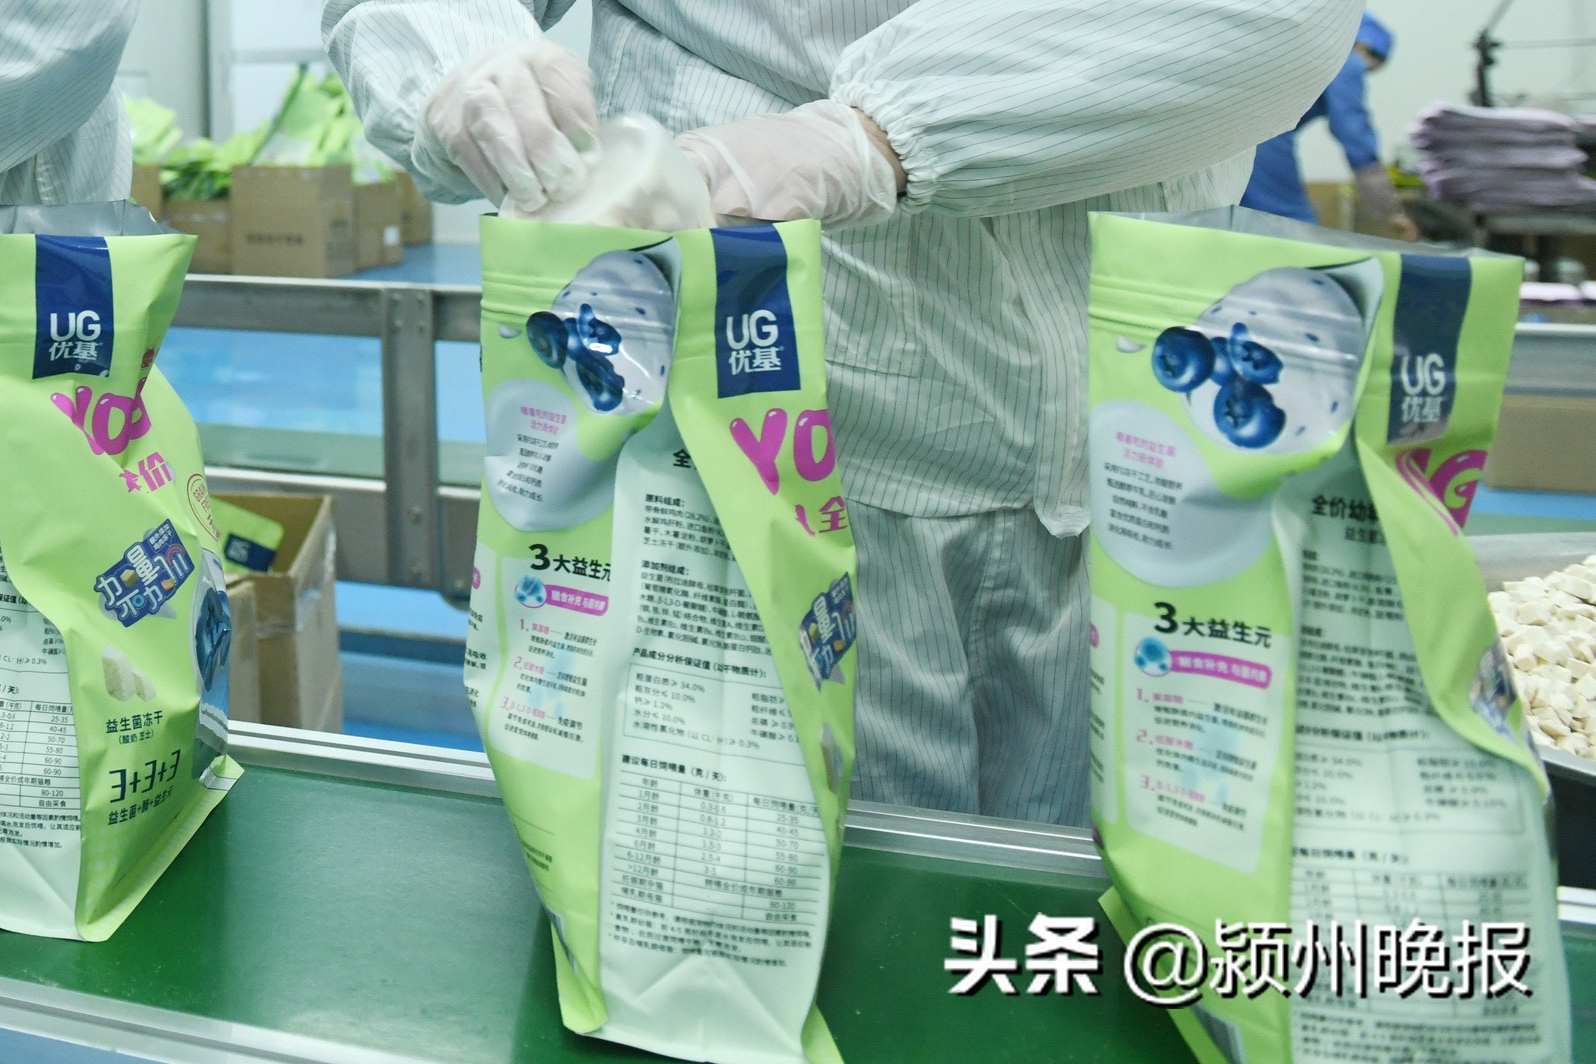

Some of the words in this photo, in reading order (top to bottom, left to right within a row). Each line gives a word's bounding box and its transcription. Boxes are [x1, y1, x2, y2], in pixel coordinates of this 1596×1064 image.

[50, 310, 100, 342] UG
[726, 309, 779, 349] UG
[49, 341, 98, 362] 优基
[728, 346, 781, 375] 优基
[1401, 353, 1446, 396] UG
[1154, 601, 1273, 649] 3大益生元
[51, 715, 69, 723] 25-35
[106, 710, 163, 734] 益生菌冻干
[49, 726, 67, 734] 40-45
[47, 736, 65, 744] 50-70
[46, 746, 63, 754] 55-80
[45, 757, 62, 765] 60-90
[44, 768, 62, 776] 60-90
[109, 749, 181, 803] 3+3+3
[41, 789, 64, 797] 80-120
[38, 799, 66, 808] 自由采食
